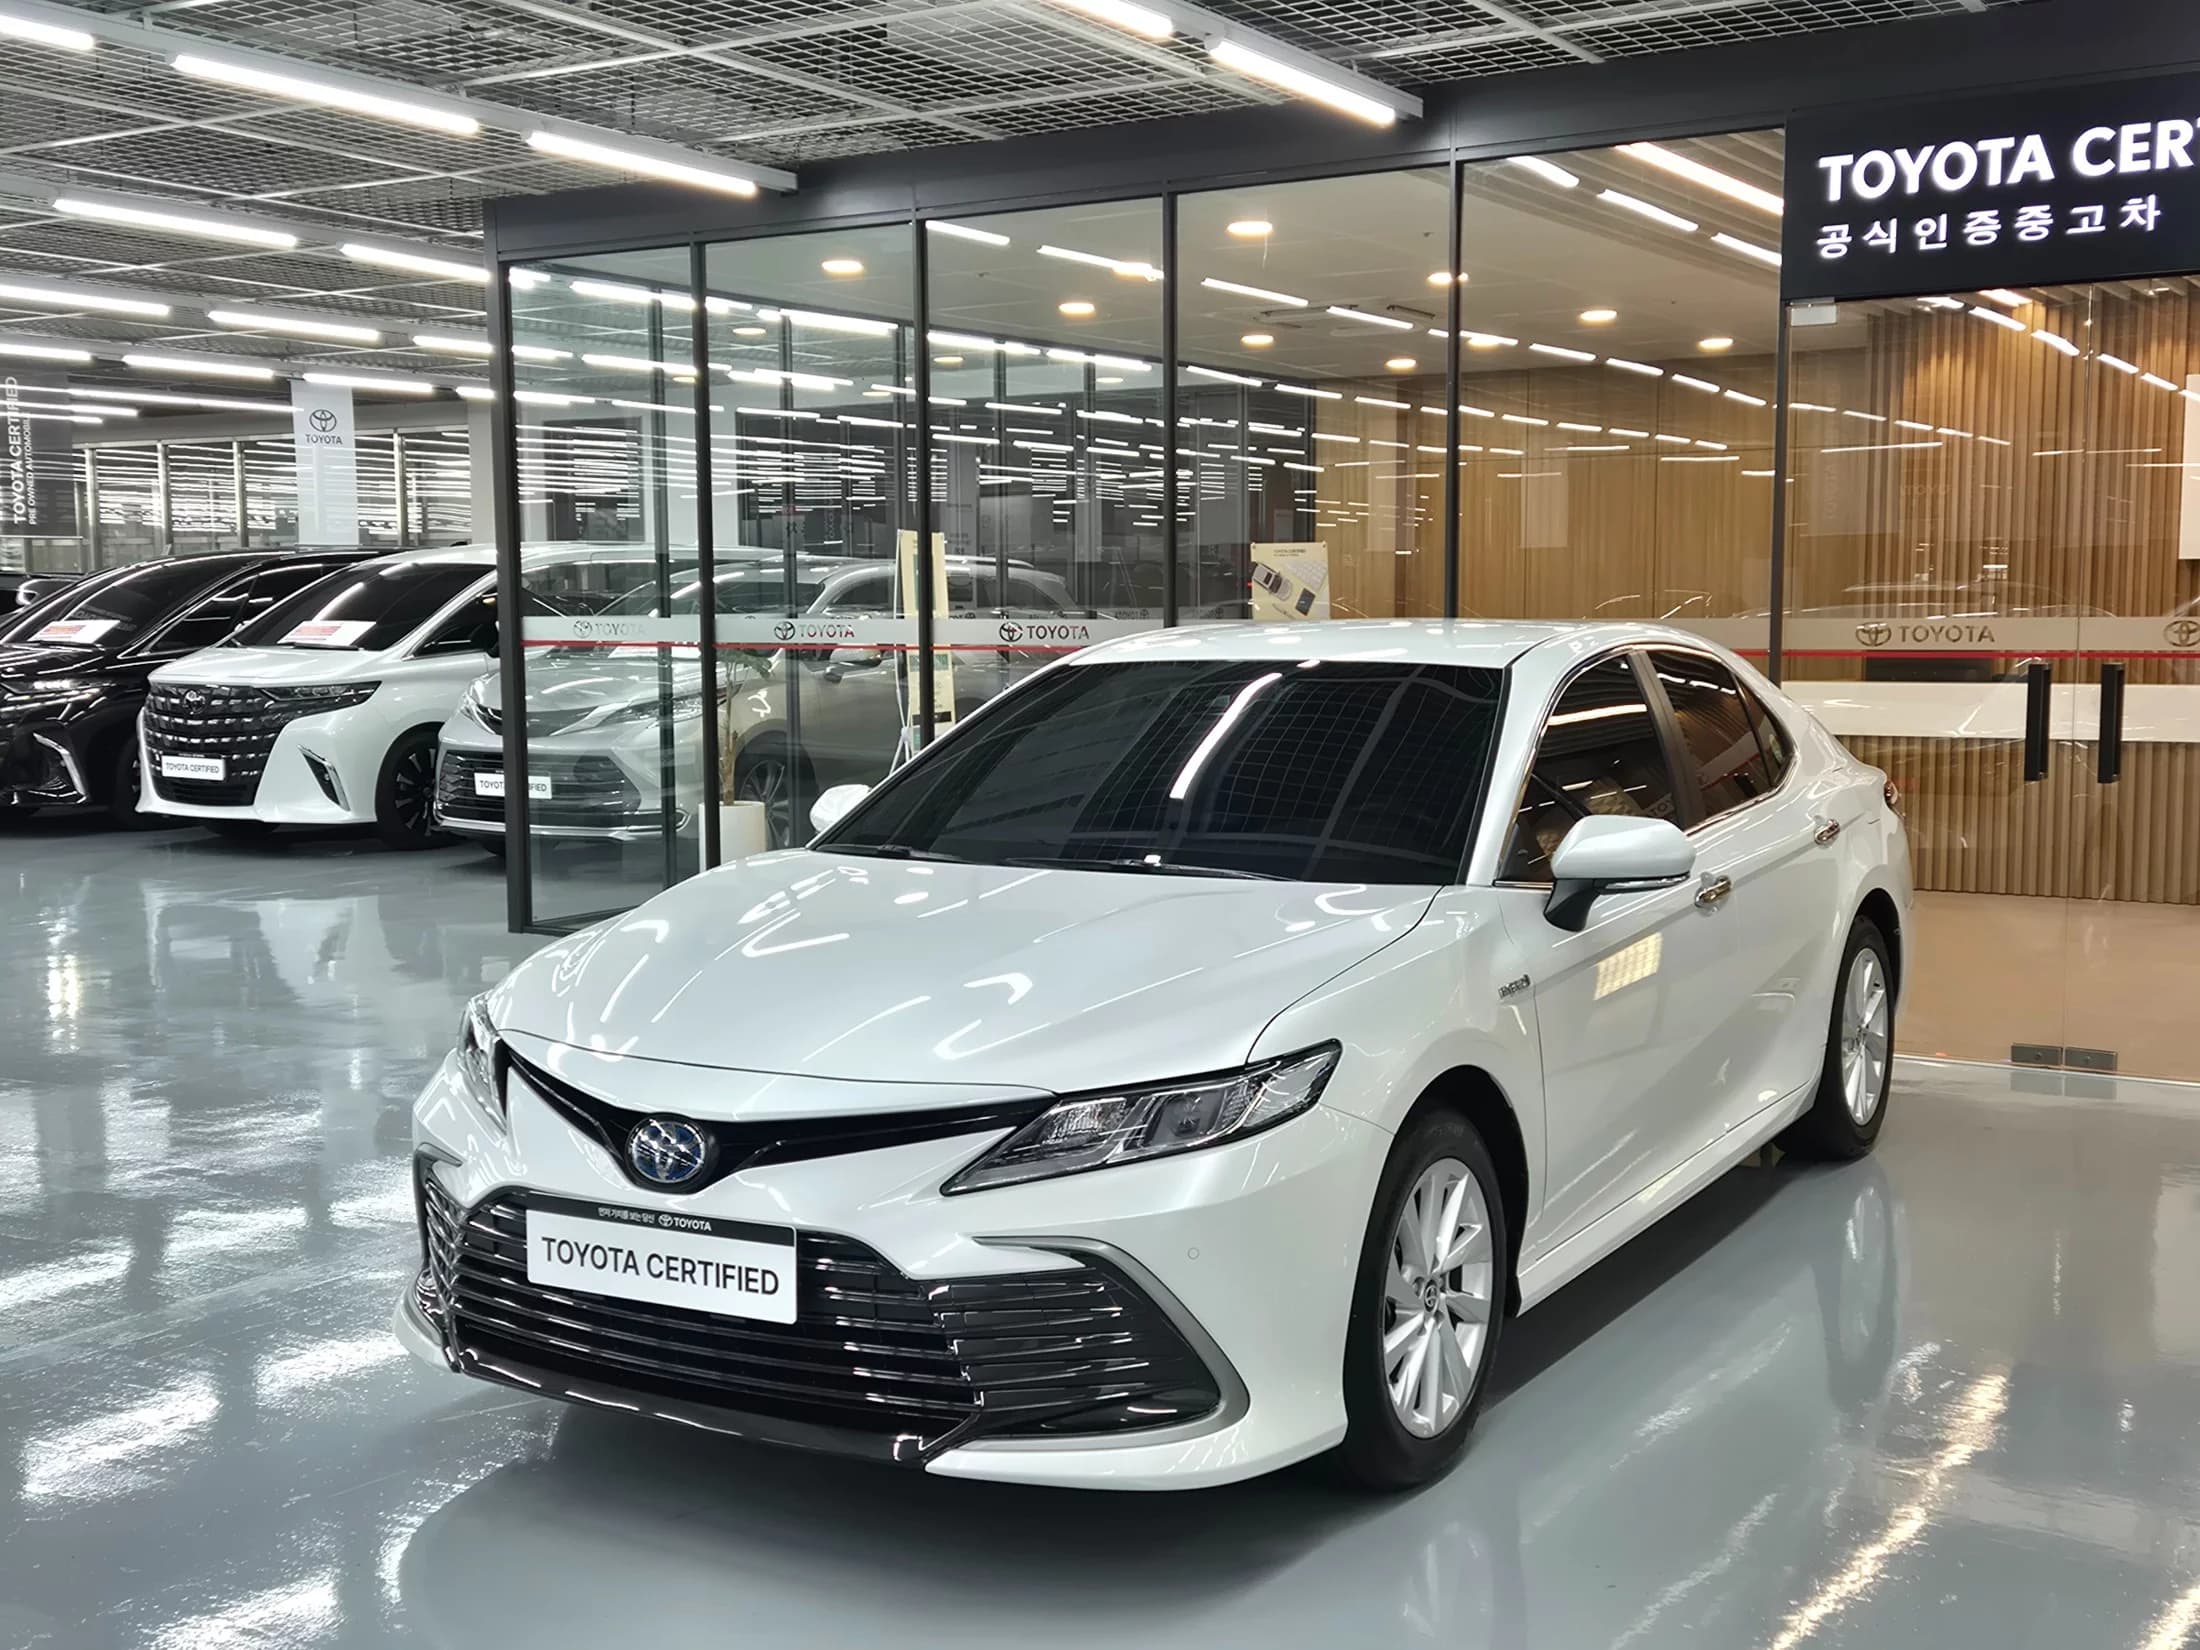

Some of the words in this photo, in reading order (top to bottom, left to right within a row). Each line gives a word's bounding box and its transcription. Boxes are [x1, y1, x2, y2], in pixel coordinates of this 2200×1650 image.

[1818, 134, 2055, 202] TOYOTA
[2072, 116, 2200, 177] CER
[5, 376, 22, 457] CERTFIED
[305, 434, 343, 445] TOYOTA
[10, 460, 27, 525] TOYOTA
[25, 472, 36, 507] OWNED
[28, 508, 37, 525] PRE
[595, 623, 647, 636] TOYOTA
[799, 624, 855, 637] TOYOTA
[1027, 624, 1090, 640] TOYOTA
[1899, 625, 1995, 643] TOYOTA
[165, 762, 189, 771] TOYOTA
[480, 780, 505, 790] TOYOT
[673, 1217, 712, 1232] TOYOTA
[541, 1236, 640, 1276] TOYOTA
[646, 1253, 780, 1296] CERTIFIED
